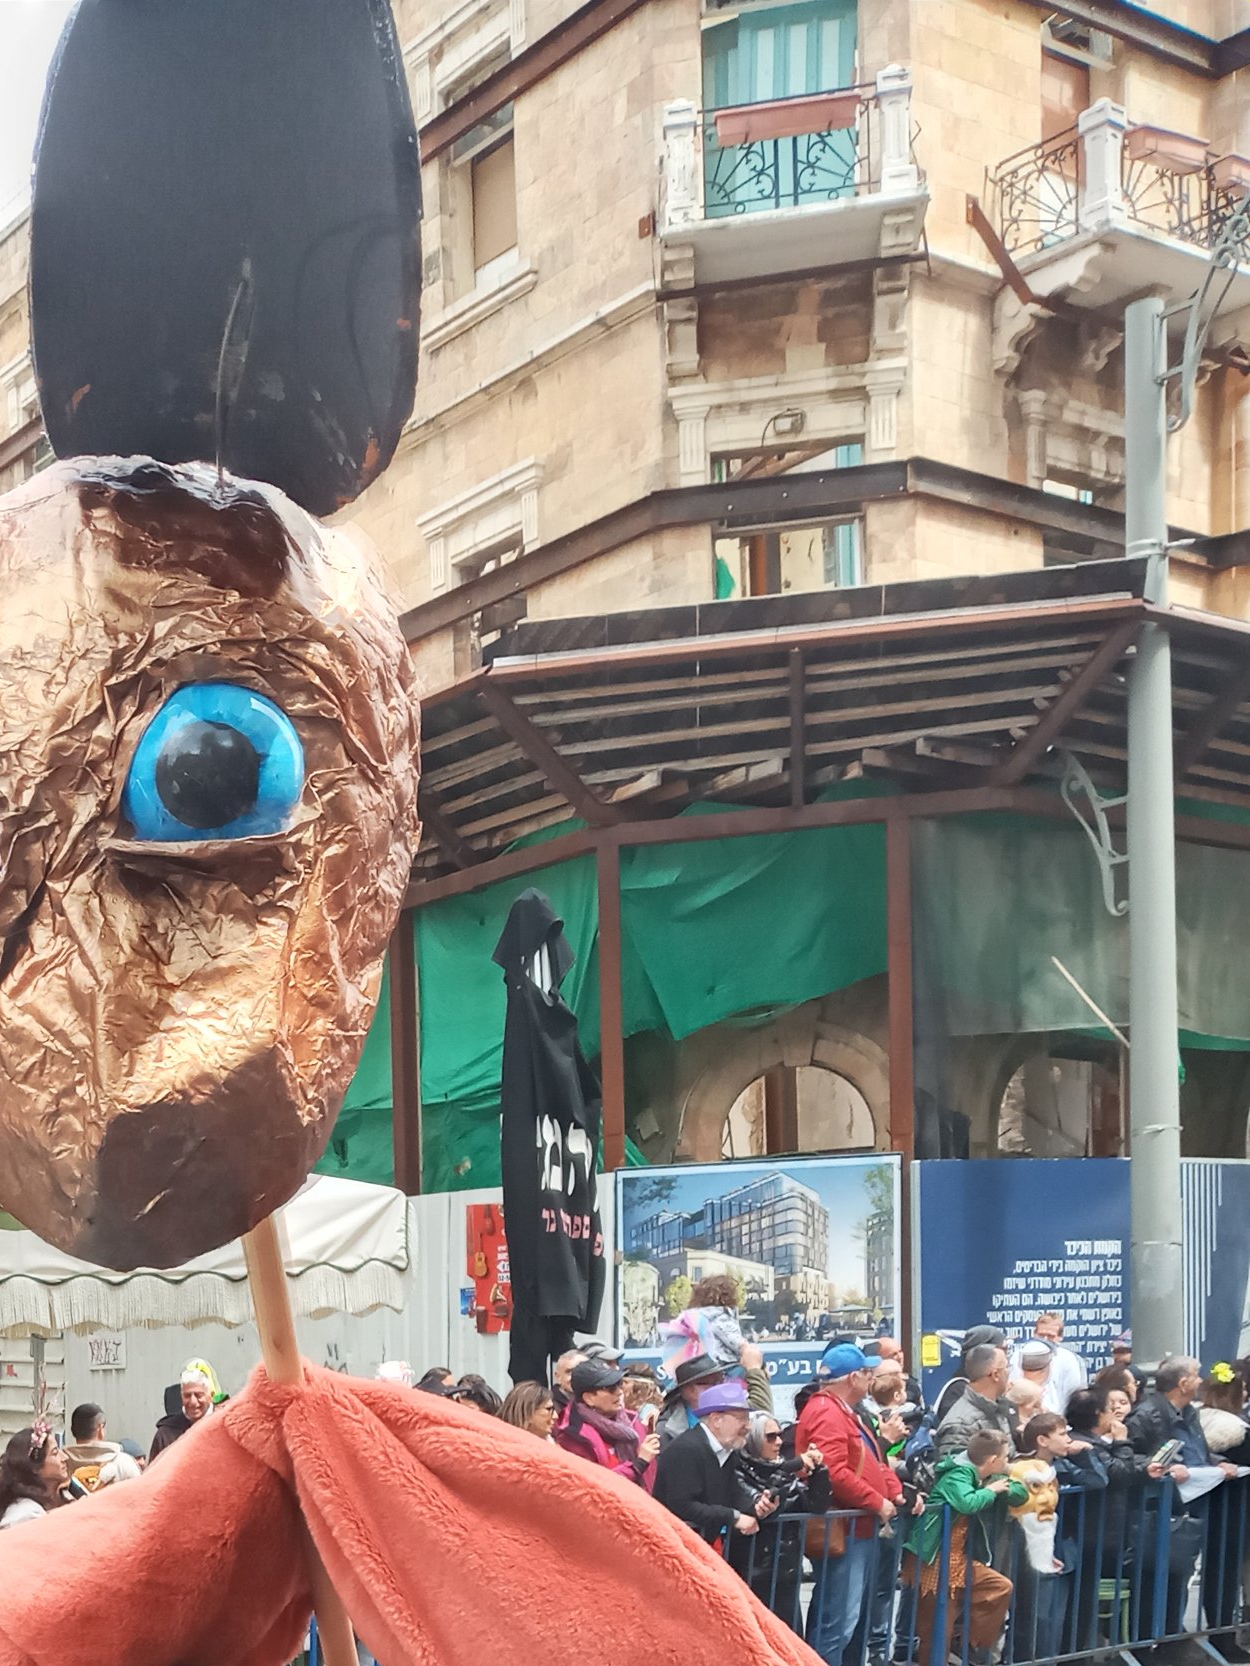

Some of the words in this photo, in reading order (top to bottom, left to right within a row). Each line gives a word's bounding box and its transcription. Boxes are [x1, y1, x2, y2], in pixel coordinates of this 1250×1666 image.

[1064, 1241, 1092, 1256] הכיכר
[1013, 1260, 1047, 1274] הבריטים,
[1049, 1260, 1064, 1272] בידי
[1065, 1260, 1089, 1274] הוקמה
[1090, 1259, 1105, 1273] ציון
[1105, 1259, 1122, 1271] כיכר
[1027, 1277, 1052, 1290] מודרני
[1021, 1293, 1033, 1306] הם
[1066, 1291, 1087, 1305] לאחר
[1088, 1291, 1122, 1305] בירושלים
